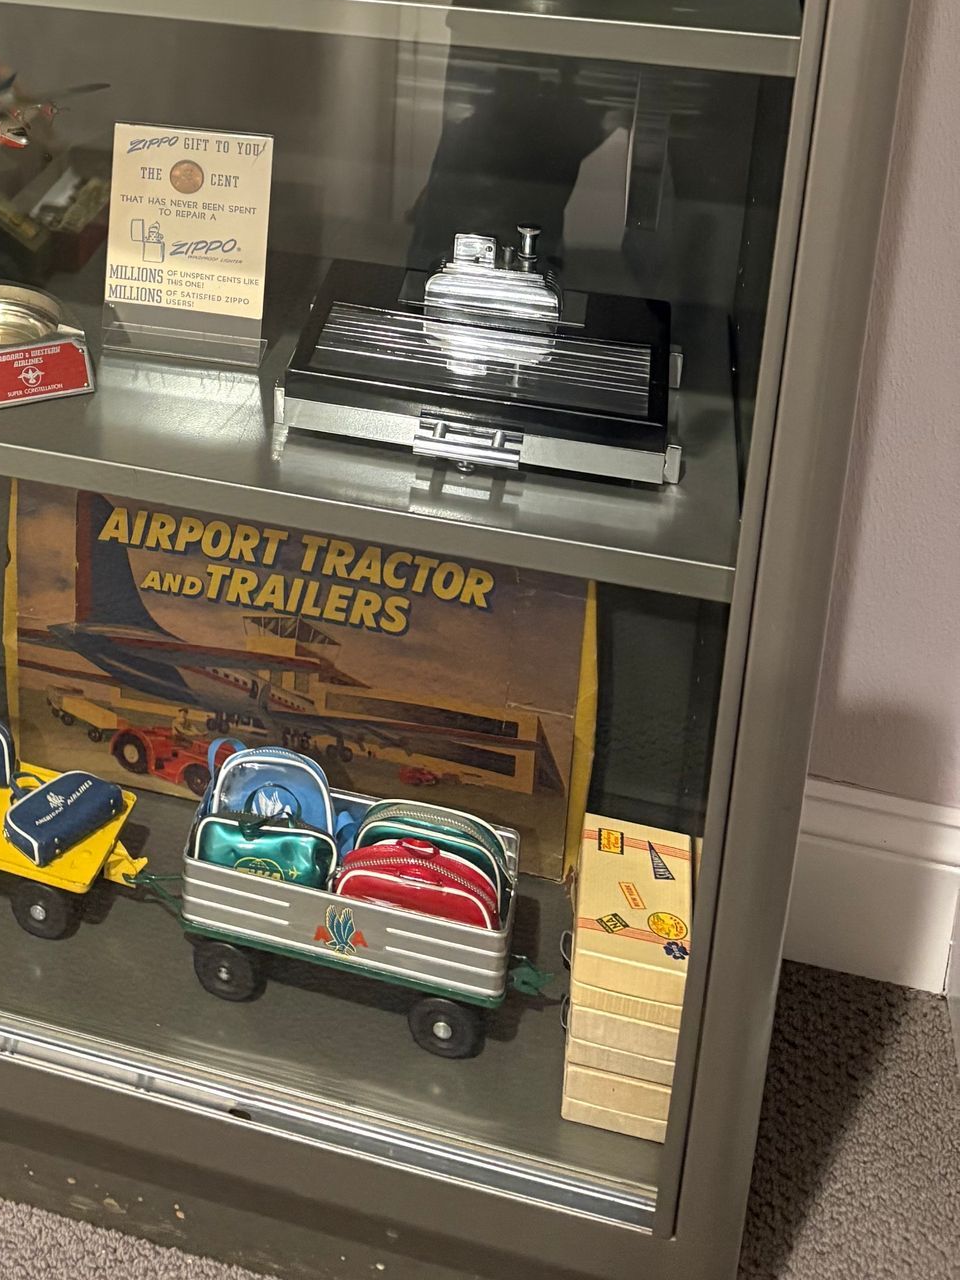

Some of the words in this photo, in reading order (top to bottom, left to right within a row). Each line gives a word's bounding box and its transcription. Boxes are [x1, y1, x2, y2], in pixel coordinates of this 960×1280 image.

[126, 136, 179, 154] ZIPPO
[184, 137, 209, 152] GIFT
[216, 140, 230, 153] TO
[140, 166, 162, 181] THE
[210, 173, 240, 188] CENT
[120, 194, 143, 204] THAT
[148, 198, 166, 206] HAS
[170, 199, 198, 209] NEVER
[202, 202, 224, 212] BEEN
[228, 205, 257, 215] SPENT
[159, 208, 172, 217] TO
[175, 210, 206, 220] REPAIR
[210, 213, 217, 221] A
[169, 238, 238, 256] ZIPPO
[109, 264, 164, 285] MILLIONS
[167, 278, 183, 287] THIS
[185, 280, 205, 289] ONE!
[180, 271, 214, 282] UNSPENT
[216, 275, 242, 285] CENTS
[243, 277, 260, 286] LIKE
[108, 284, 163, 304] MILLIONS
[166, 289, 177, 297] OF
[180, 291, 222, 302] SATISFIED
[225, 296, 250, 305] ZIPPO
[166, 299, 195, 308] USERS!
[97, 506, 289, 566] AIRPORT
[300, 535, 496, 610] TRACTOR
[140, 569, 203, 597] AND
[203, 563, 412, 635] TRAILERS
[35, 806, 64, 826] AMERICAN
[67, 780, 93, 806] AIRLINES
